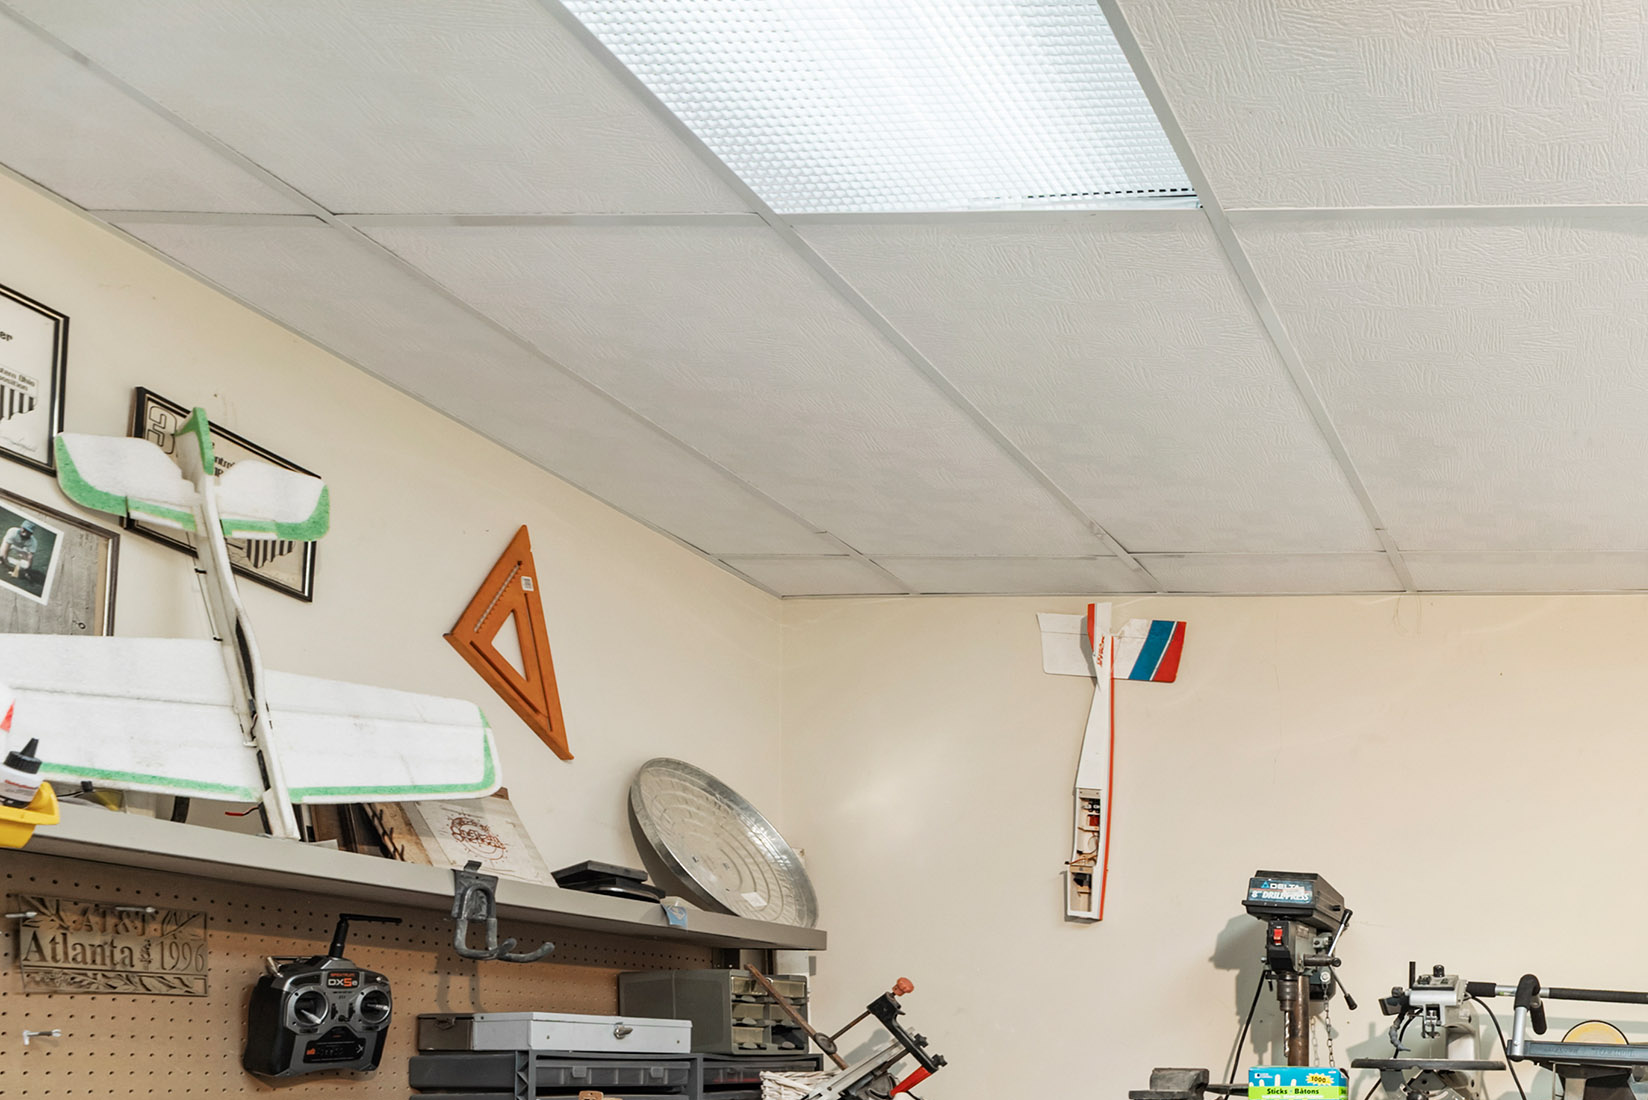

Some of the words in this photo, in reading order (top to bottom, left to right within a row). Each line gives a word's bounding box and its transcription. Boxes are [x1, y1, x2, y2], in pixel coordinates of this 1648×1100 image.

[22, 930, 135, 968] Atlanta
[158, 940, 205, 972] 1996
[1294, 1087, 1320, 1095] Bâtons
